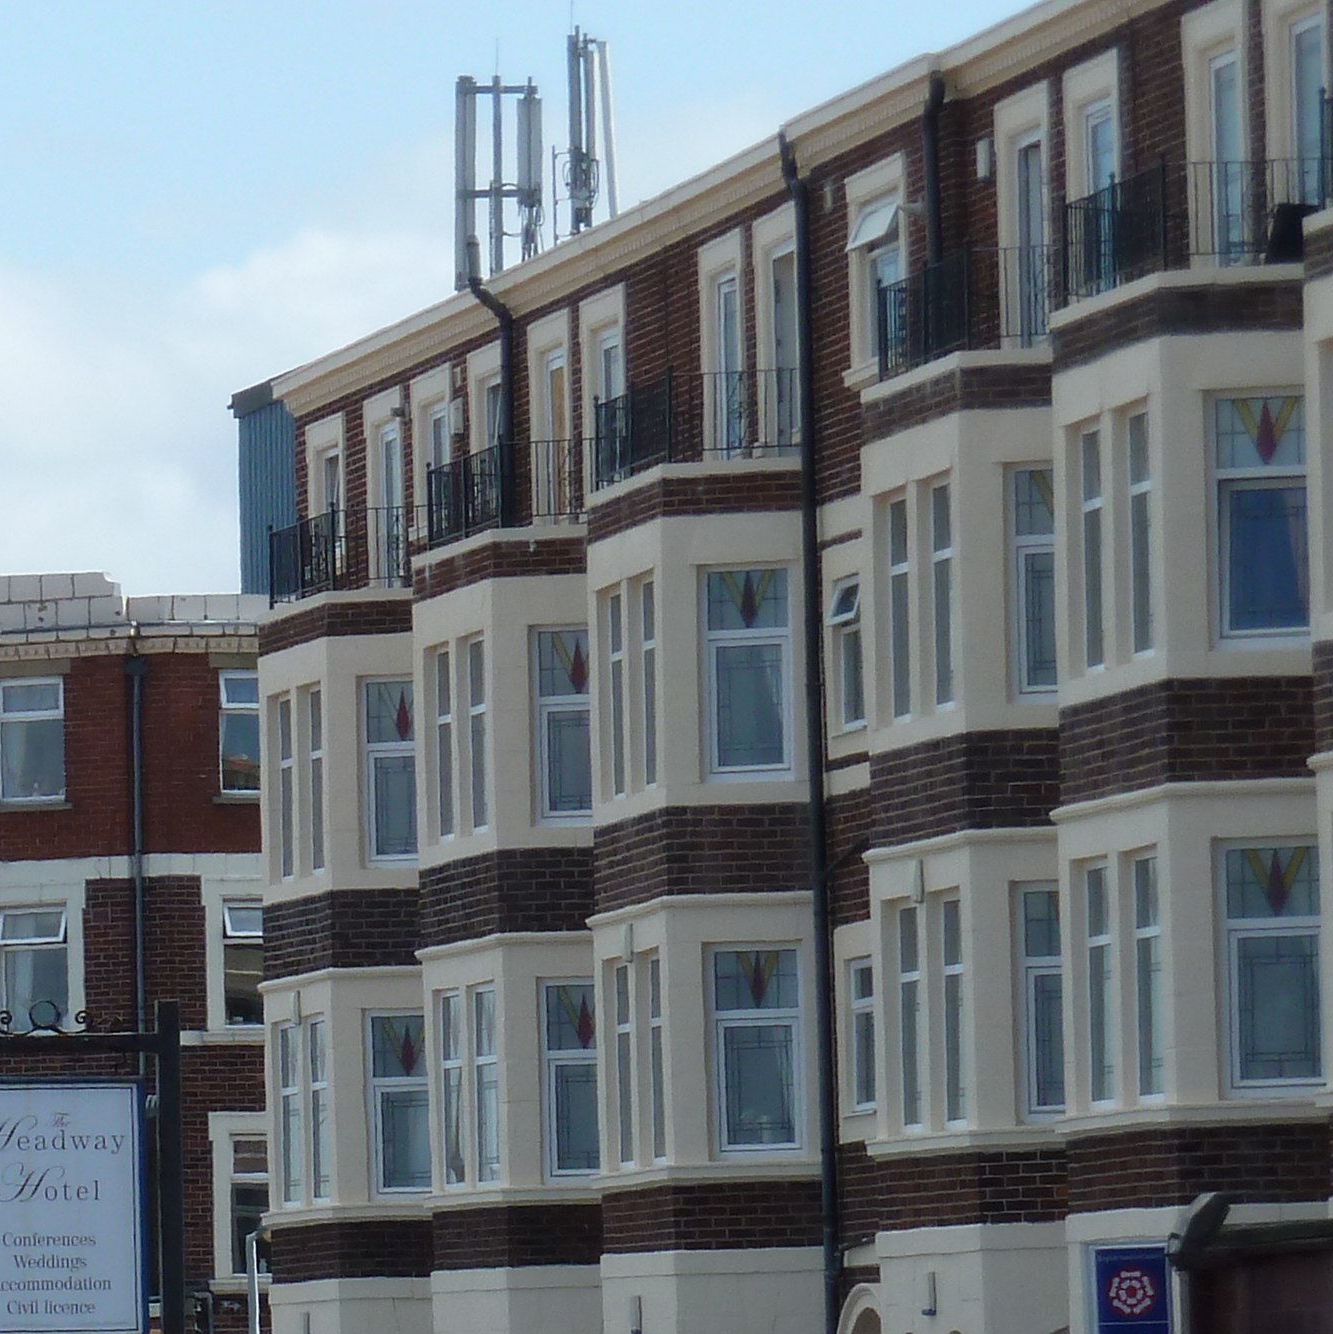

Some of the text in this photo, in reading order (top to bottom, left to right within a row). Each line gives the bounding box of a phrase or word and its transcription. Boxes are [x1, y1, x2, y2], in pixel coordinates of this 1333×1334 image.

[51, 1112, 71, 1128] The
[1, 1231, 97, 1248] Conferences
[12, 1253, 88, 1272] Weddings
[6, 1299, 97, 1315] Civil licence
